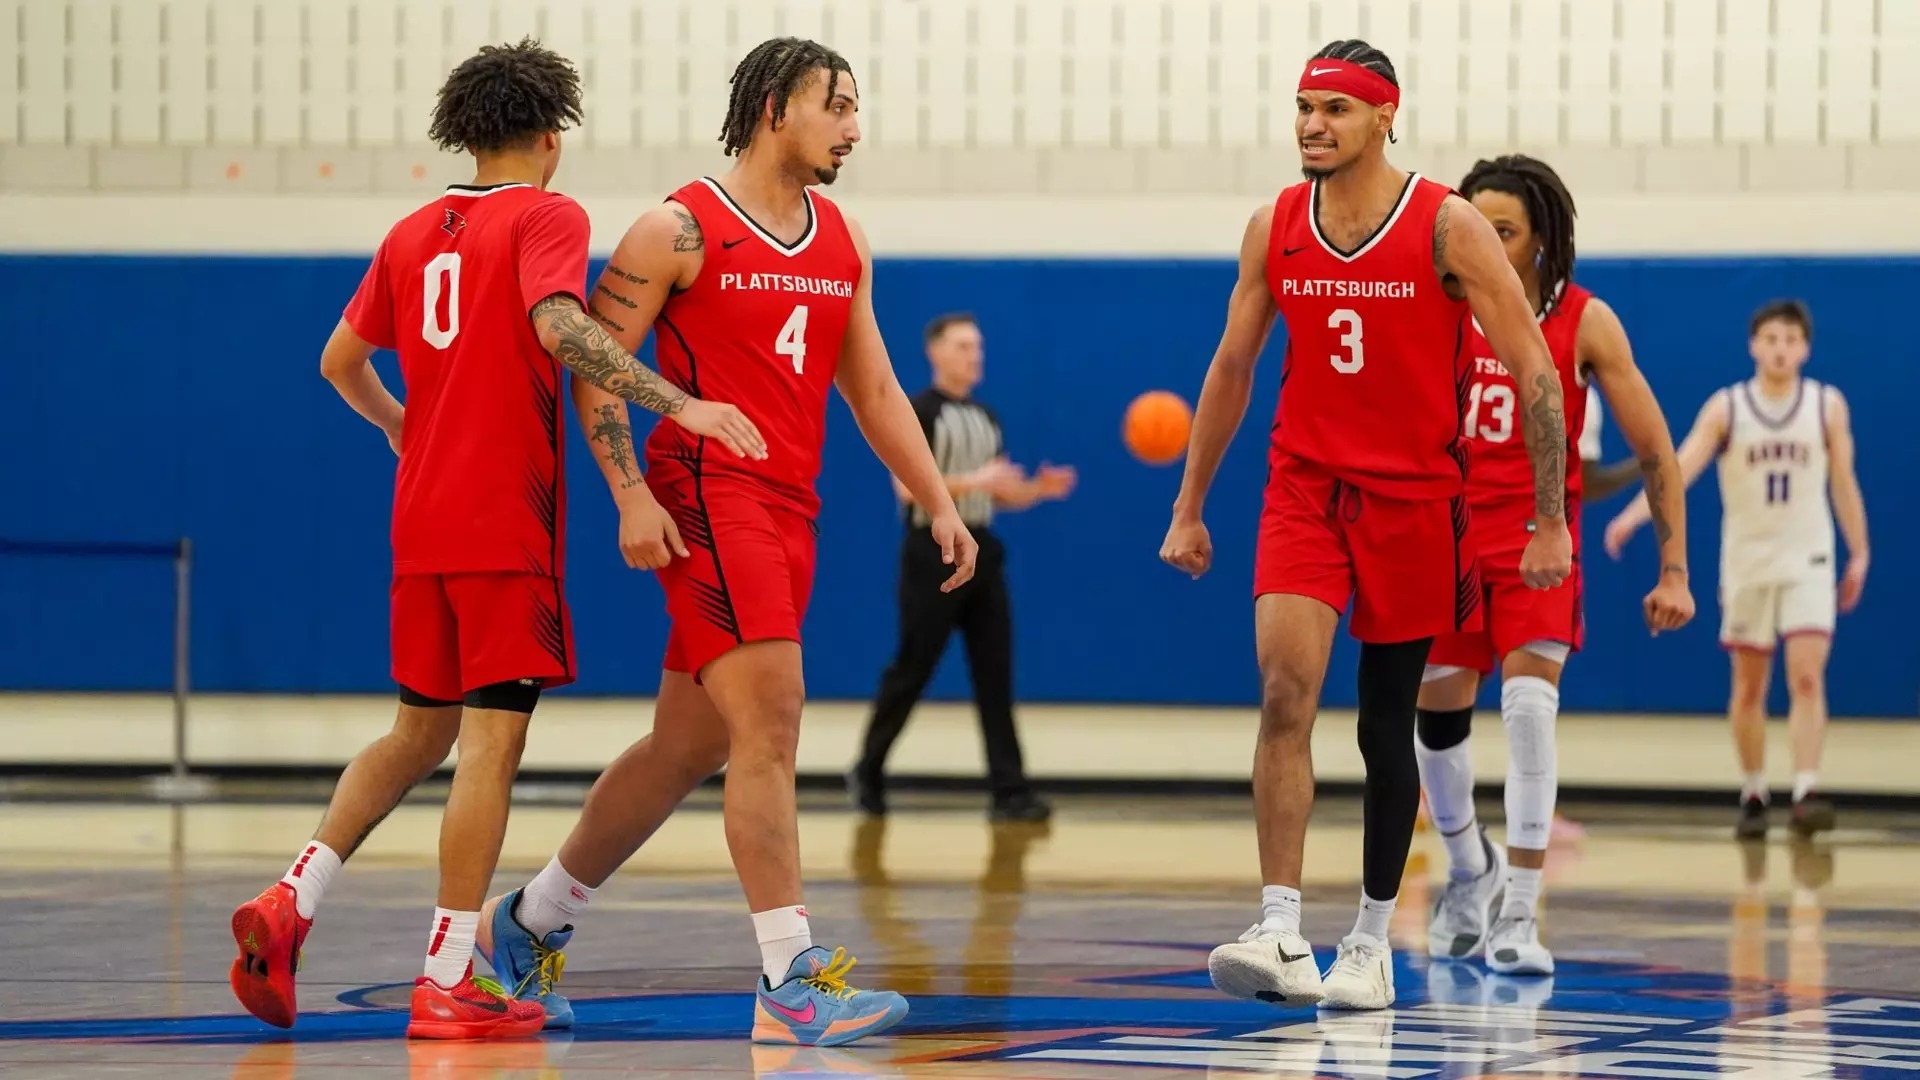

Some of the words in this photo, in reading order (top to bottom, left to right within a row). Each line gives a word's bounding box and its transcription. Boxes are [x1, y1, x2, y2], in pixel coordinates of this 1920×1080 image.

[421, 251, 462, 350] 0
[720, 272, 853, 299] PLATTSBURGH
[1282, 279, 1416, 299] PLATTSBURGH
[774, 304, 809, 375] 4
[1327, 308, 1365, 374] 3
[1464, 382, 1516, 443] 13
[1766, 470, 1791, 504] 11
